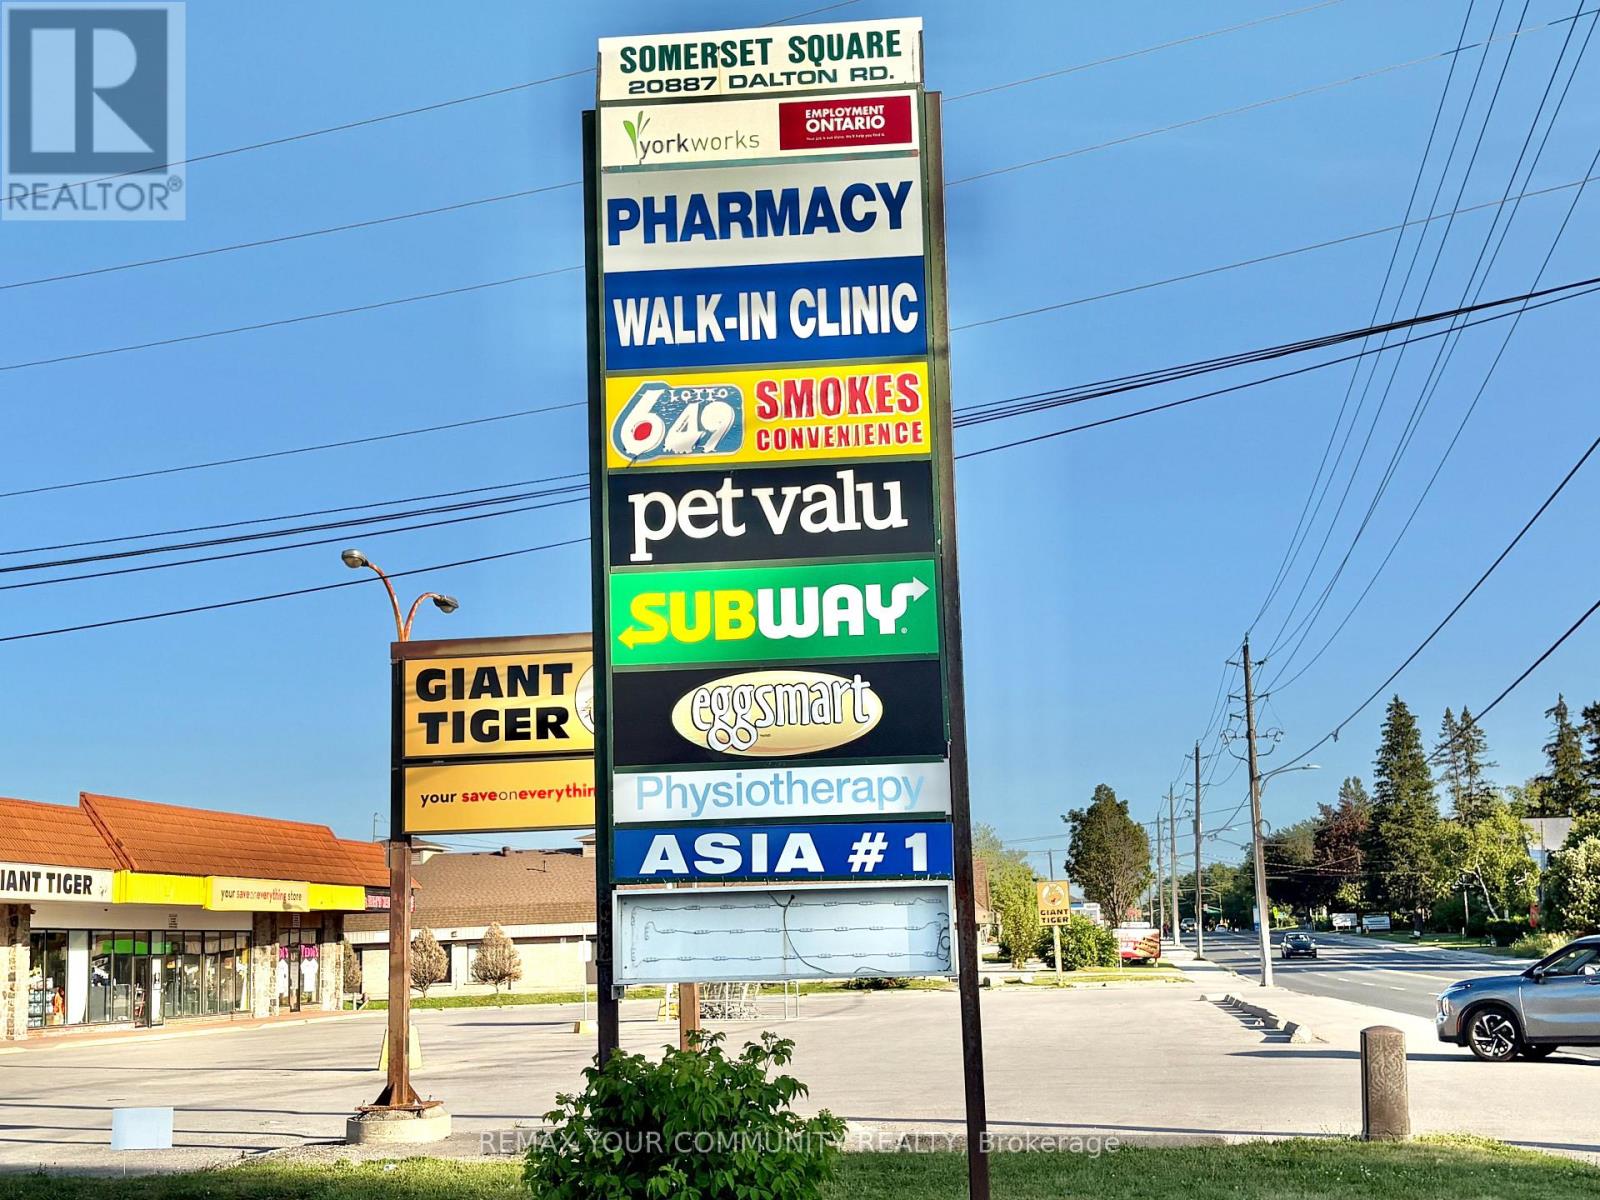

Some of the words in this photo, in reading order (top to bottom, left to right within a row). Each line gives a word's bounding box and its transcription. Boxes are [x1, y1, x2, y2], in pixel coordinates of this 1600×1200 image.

[620, 38, 773, 74] SOMERSET
[788, 29, 902, 67] SQUARE
[628, 76, 718, 94] 20887
[728, 69, 838, 89] DALTON
[850, 66, 894, 81] RD.
[805, 104, 885, 119] EMPLOYMENT
[805, 114, 886, 133] ONTARIO
[607, 180, 914, 246] PHARMACY
[612, 290, 777, 348] WALK-IN
[789, 282, 919, 339] CLINIC
[669, 387, 729, 403] LOTTO
[756, 373, 920, 421] SMOKES
[756, 421, 923, 452] CONVENIENCE
[628, 477, 746, 562] pet
[752, 469, 908, 535] valu
[617, 576, 930, 650] SUBWAY
[415, 662, 573, 702] GIANT
[418, 706, 570, 744] TIGER
[691, 673, 871, 752] eggsmart
[420, 791, 457, 808] your
[636, 771, 925, 817] Physiotherapy
[638, 832, 825, 875] ASIA
[46, 872, 93, 895] TIGER
[221, 889, 236, 902] your
[287, 890, 302, 901] store
[1040, 908, 1069, 916] GIANT
[1041, 916, 1069, 924] TIGER
